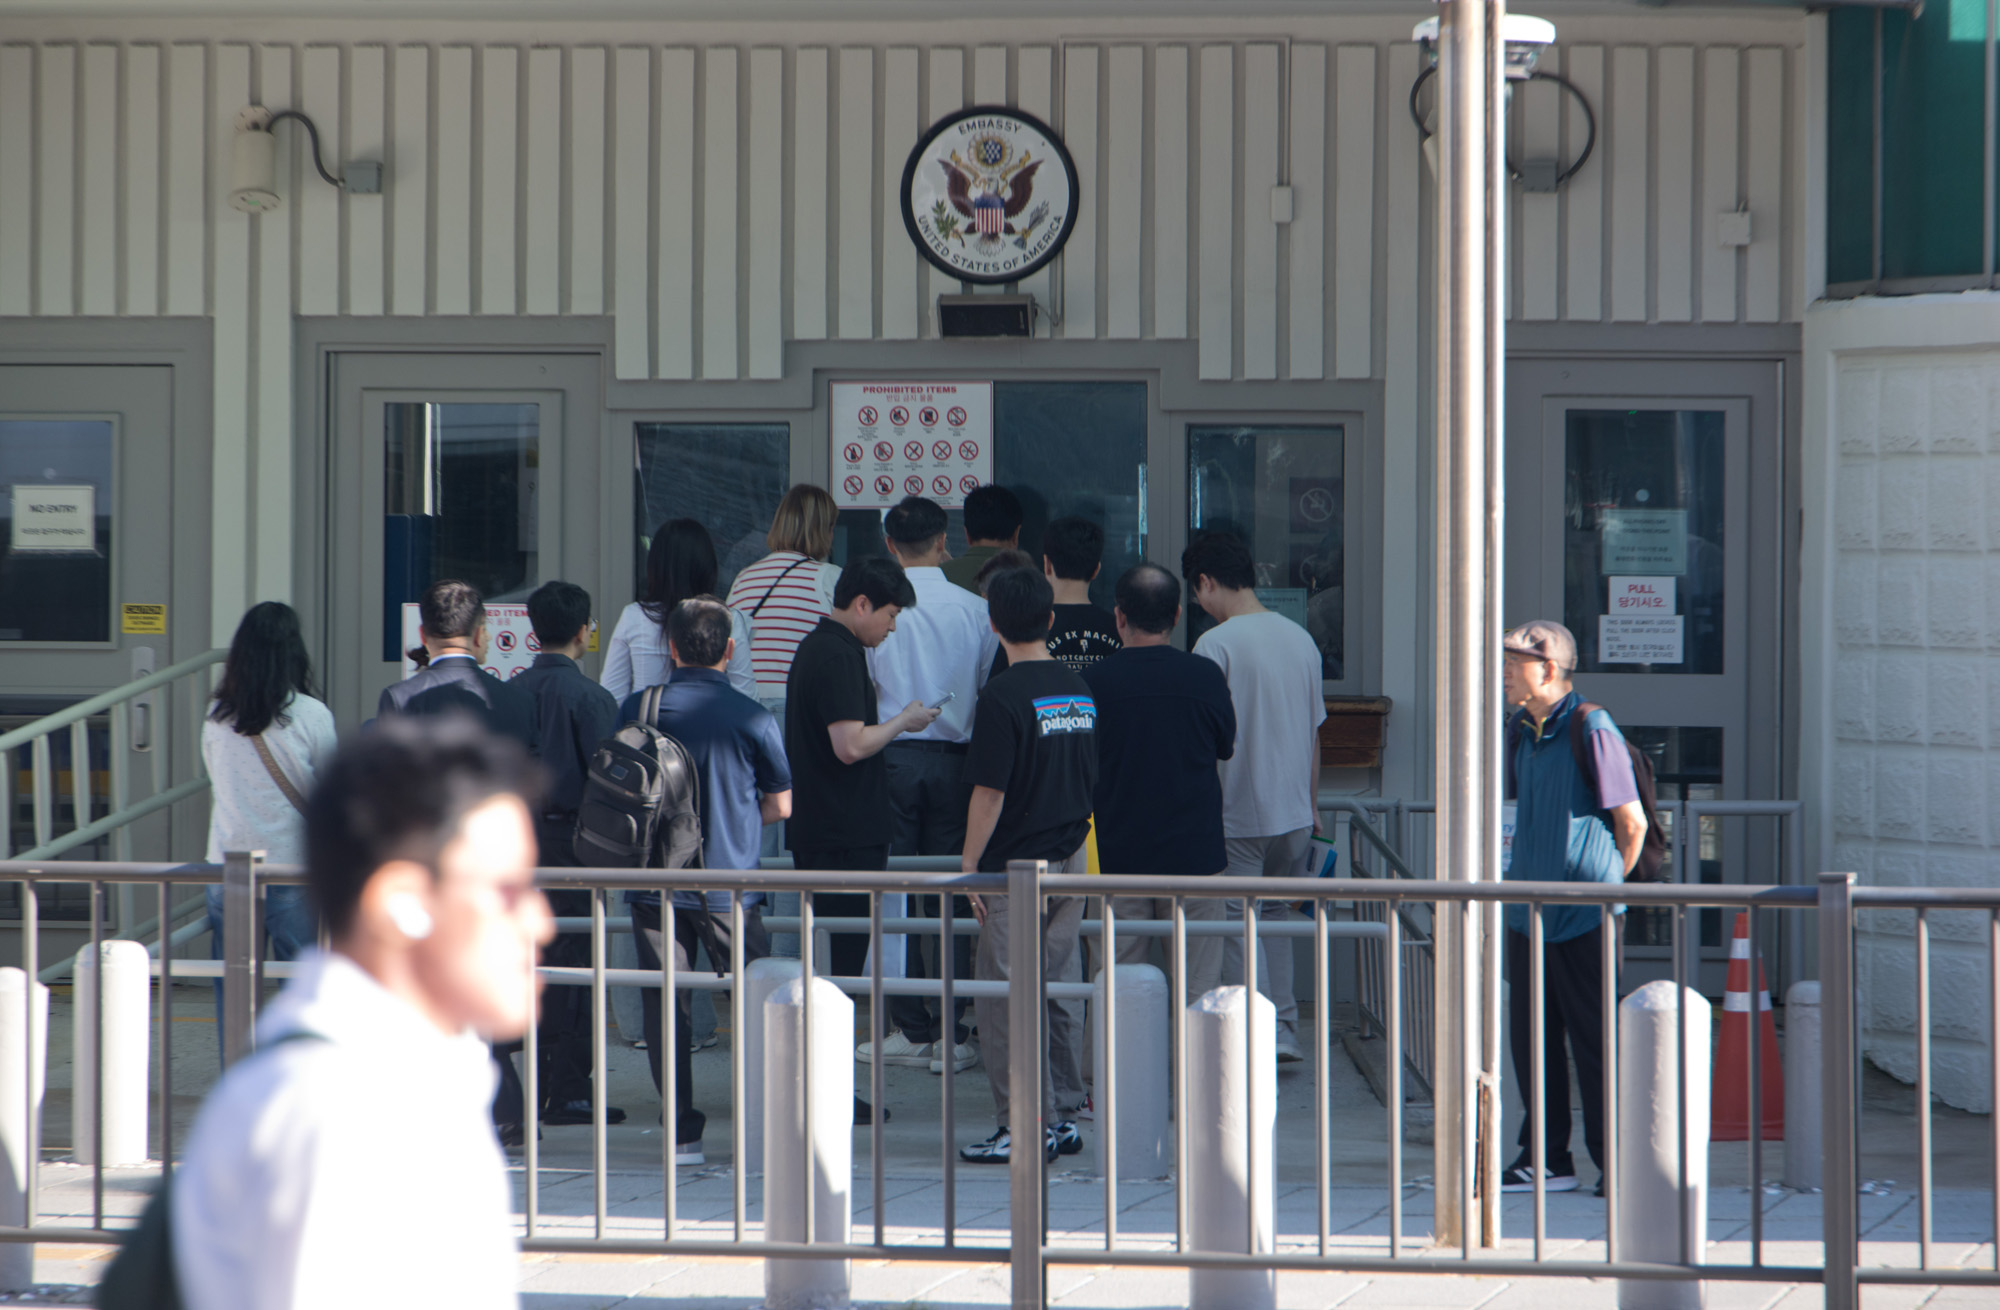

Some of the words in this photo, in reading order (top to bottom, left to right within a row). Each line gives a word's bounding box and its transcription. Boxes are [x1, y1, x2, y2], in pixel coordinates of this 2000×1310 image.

[958, 118, 1022, 135] EMBASSY
[918, 215, 950, 257] UNITED
[951, 254, 1000, 273] STATES
[1003, 257, 1020, 271] OF
[1022, 215, 1063, 264] AMERICA
[862, 386, 924, 394] PROHIBITED
[926, 386, 957, 394] ITEMS
[28, 504, 45, 513] NO
[46, 504, 79, 513] ENTRY
[1628, 584, 1656, 594] PULL
[1048, 637, 1062, 650] US
[1065, 630, 1078, 640] EX
[1083, 630, 1120, 649] MACHI
